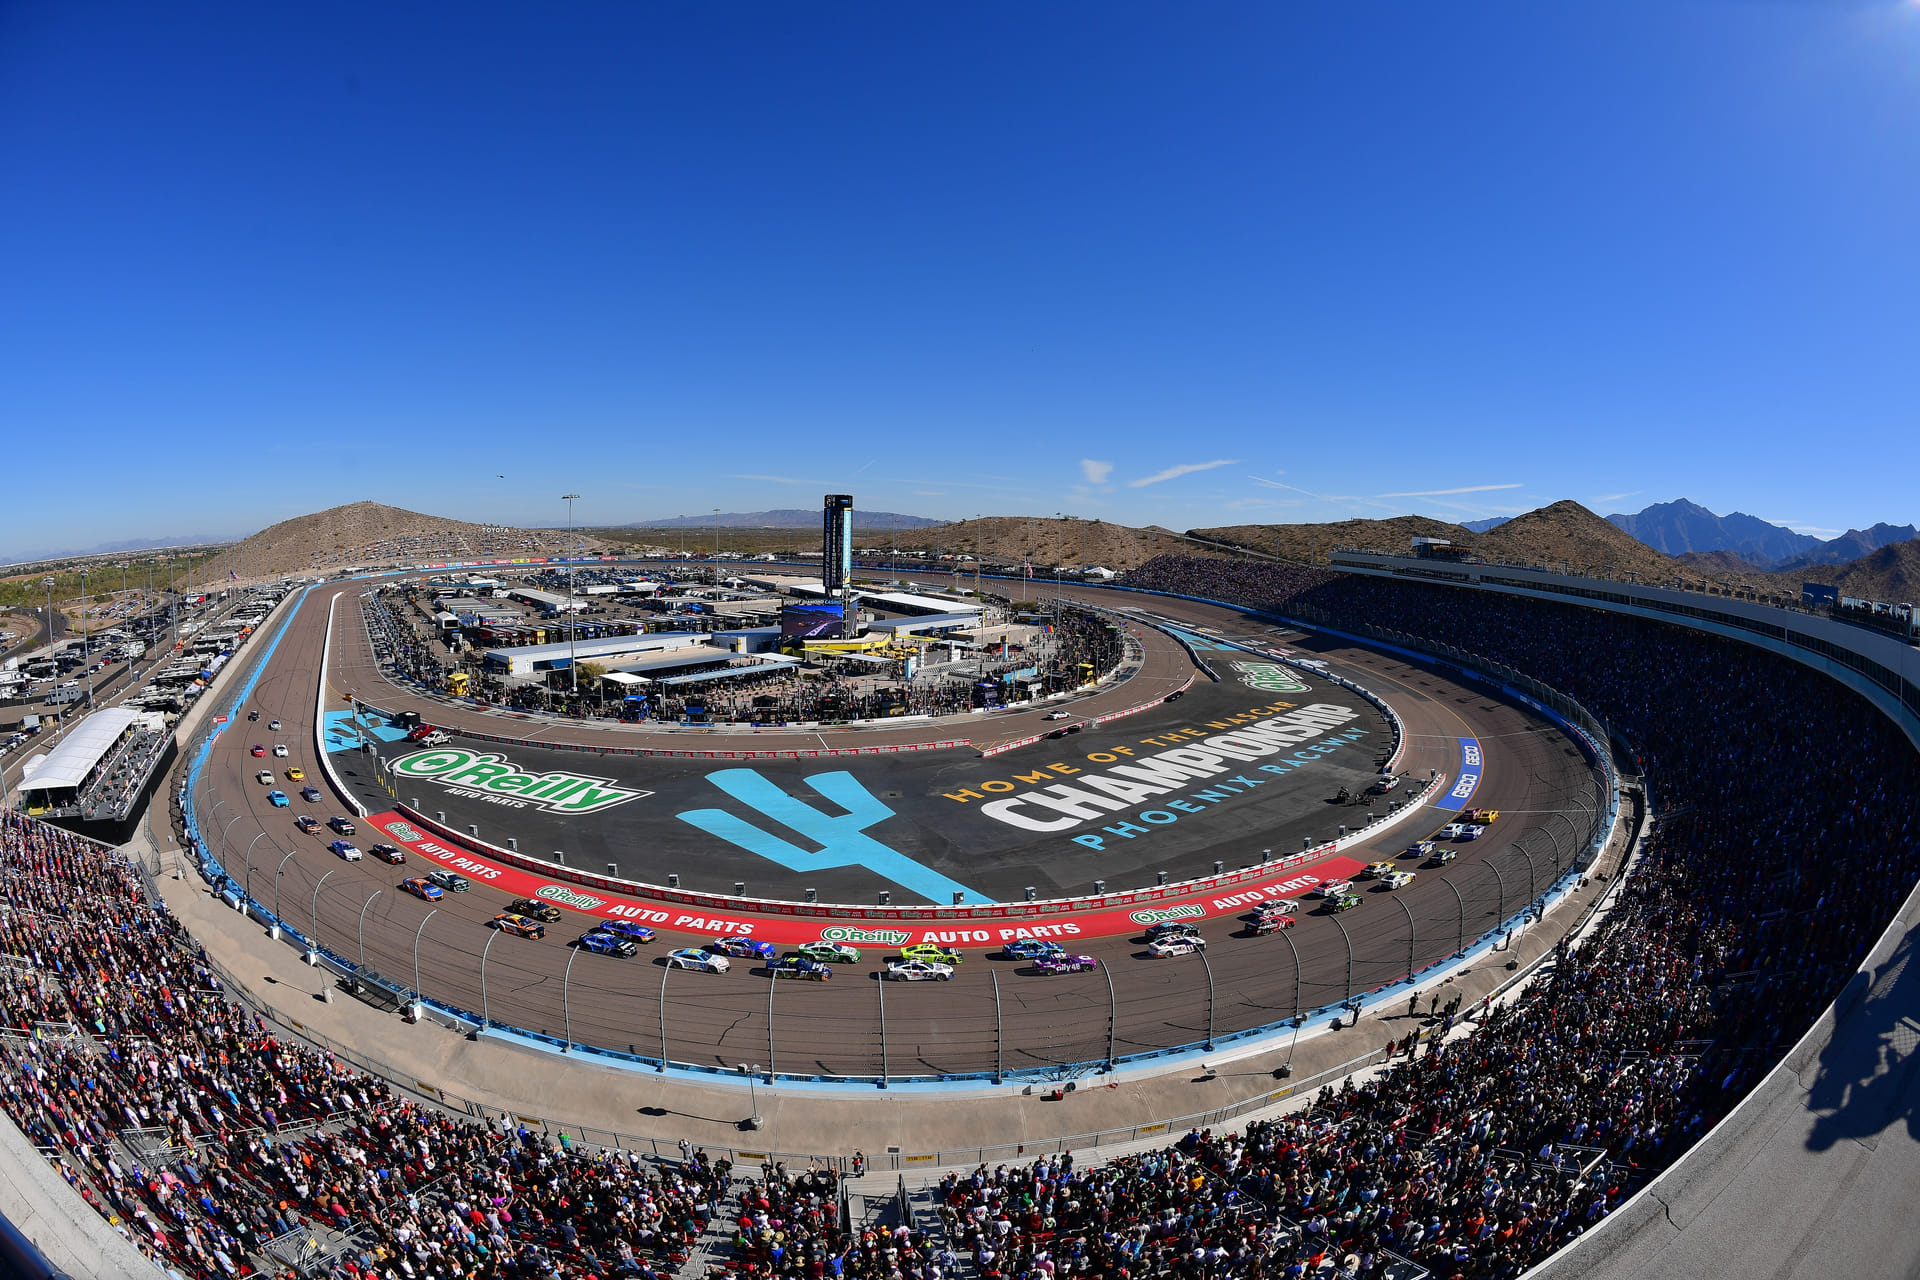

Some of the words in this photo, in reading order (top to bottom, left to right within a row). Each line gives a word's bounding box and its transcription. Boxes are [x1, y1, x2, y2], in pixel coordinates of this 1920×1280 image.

[942, 762, 1082, 803] HOME
[1086, 744, 1138, 763] OF
[1139, 726, 1208, 748] THE
[1205, 700, 1299, 729] NASCAR
[980, 703, 1361, 832] CHAMPIONSHIP
[399, 750, 628, 810] O'Reilly
[443, 787, 480, 799] AUTO
[480, 794, 529, 809] PARTS
[1071, 774, 1265, 851] PHOENIX
[1258, 726, 1371, 776] RACEWAY
[1451, 773, 1478, 798] GEICO
[417, 842, 454, 860] AUTO
[449, 856, 502, 879] PARTS
[538, 886, 602, 909] O'Reilly
[607, 904, 667, 922] AUTO
[673, 915, 755, 935] PARTS
[1132, 905, 1203, 924] O'Reilly
[1212, 891, 1265, 910] AUTO
[1261, 874, 1321, 896] PARTS
[823, 927, 907, 944] O'Reilly
[922, 929, 990, 944] AUTO
[999, 922, 1081, 941] PARTS
[1056, 963, 1071, 972] ally
